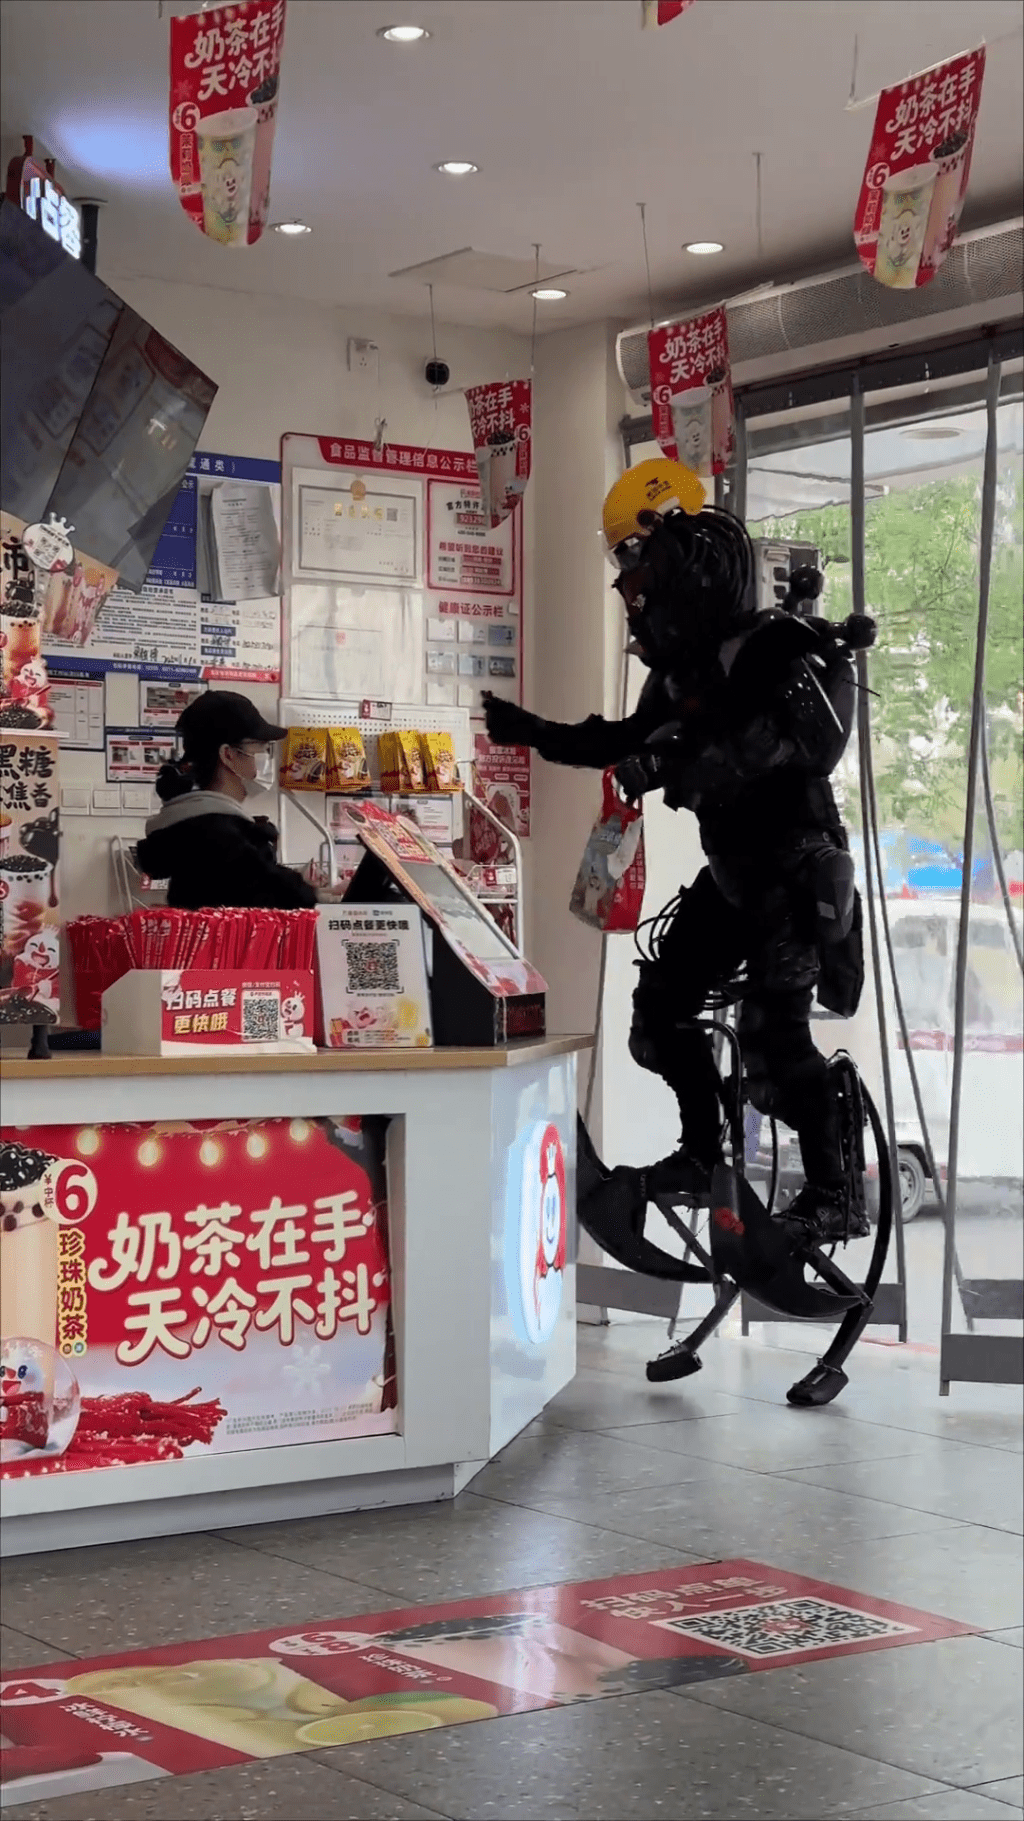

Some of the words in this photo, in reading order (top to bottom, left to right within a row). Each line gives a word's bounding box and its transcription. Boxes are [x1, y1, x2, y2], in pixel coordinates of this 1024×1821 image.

[184, 4, 284, 68] 奶茶在手
[886, 61, 976, 133] 奶茶在手
[181, 104, 197, 131] 6
[890, 92, 973, 160] 天冷不抖
[873, 165, 887, 187] 6
[659, 317, 723, 363] 奶茶在手
[467, 386, 514, 417] 茶在手
[659, 387, 670, 401] 6
[518, 425, 529, 441] 6
[439, 601, 504, 617] 健康证公示栏
[0, 744, 55, 780] 黑糖
[328, 919, 410, 931] 扫码点餐更快哦
[165, 988, 238, 1011] 扫码点餐
[174, 1012, 229, 1035] 更快哦
[55, 1164, 90, 1221] 6
[88, 1190, 367, 1291] 奶茶在手
[58, 1230, 86, 1341] 珍珠奶茶
[116, 1263, 376, 1366] 天冷不抖
[580, 1575, 766, 1611] 扫码点单
[610, 1585, 788, 1620] 快人一步
